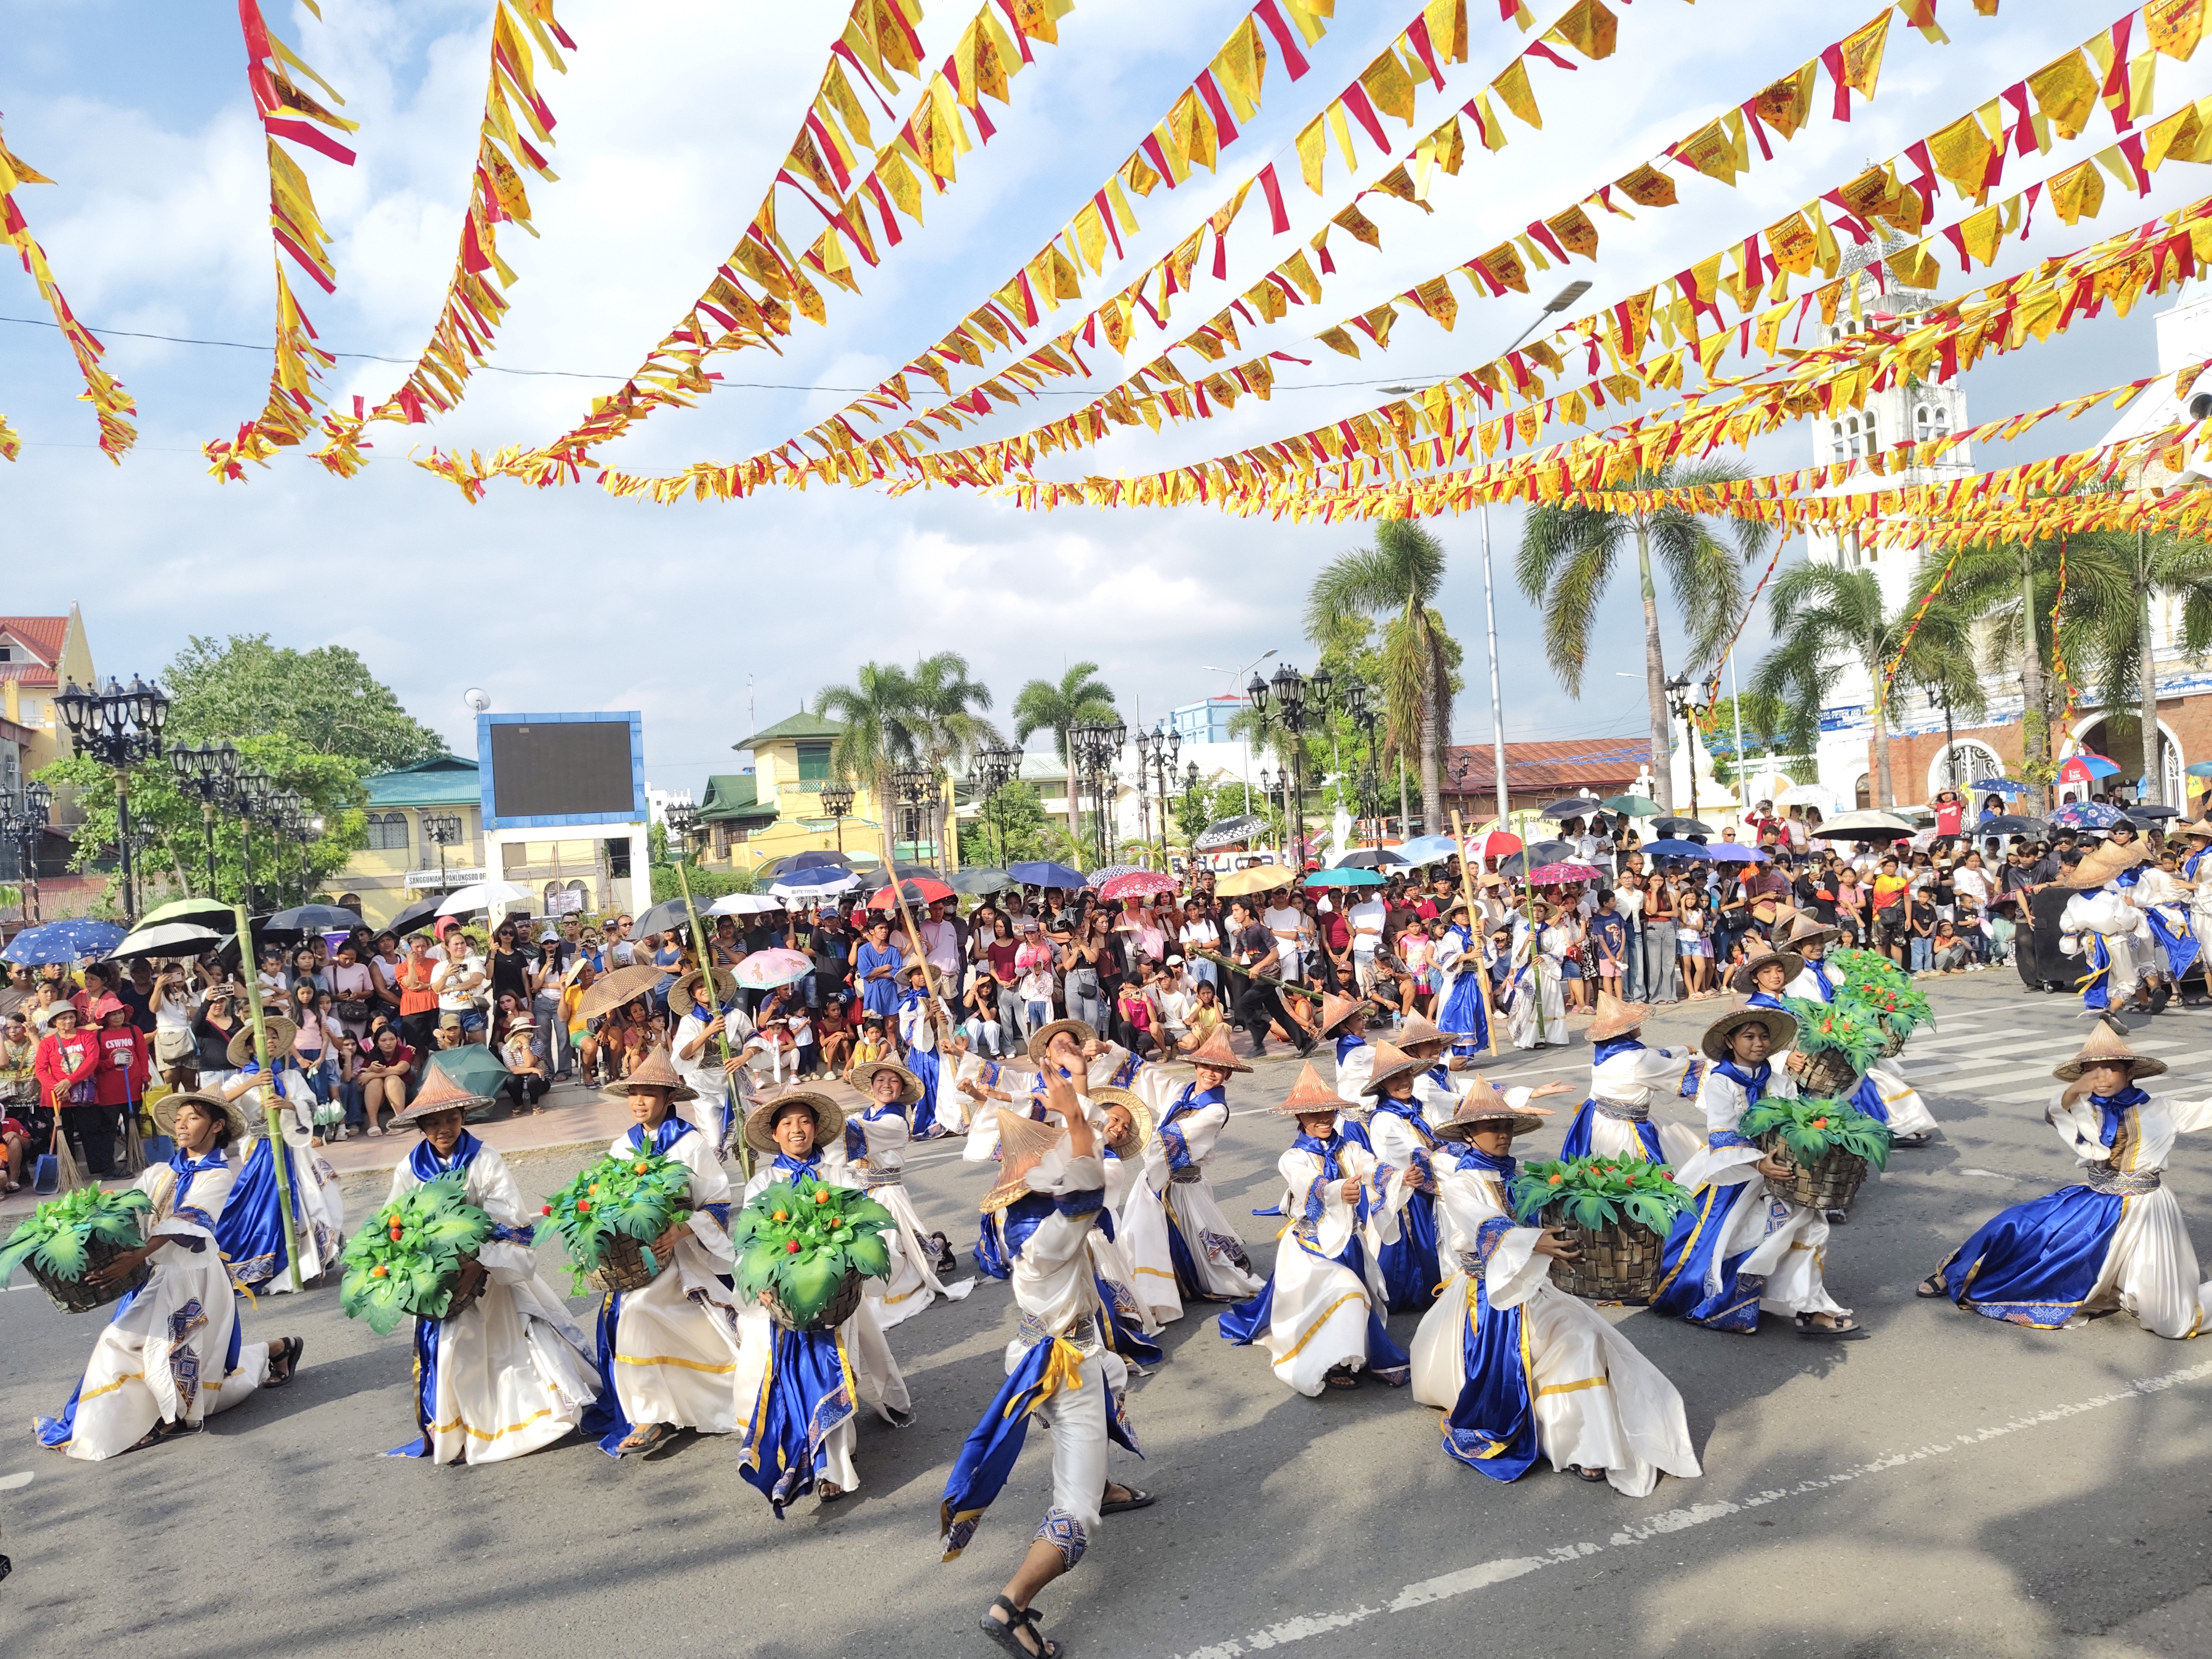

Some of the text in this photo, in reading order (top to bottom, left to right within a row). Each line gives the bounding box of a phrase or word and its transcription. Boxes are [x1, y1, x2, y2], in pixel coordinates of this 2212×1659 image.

[1864, 26, 1878, 38] Miguel
[1855, 181, 1882, 200] FIESTA
[1781, 222, 1790, 231] Miguel
[1777, 225, 1799, 244] FIESTA
[1851, 708, 1861, 717] AND
[1730, 766, 1739, 774] Lad
[1530, 816, 1553, 826] CENTRAL
[409, 875, 446, 885] SANGGUNIAN
[446, 873, 478, 882] PANLUNGSOD
[58, 1042, 85, 1055] CWMO
[105, 1037, 133, 1049] CSWMO
